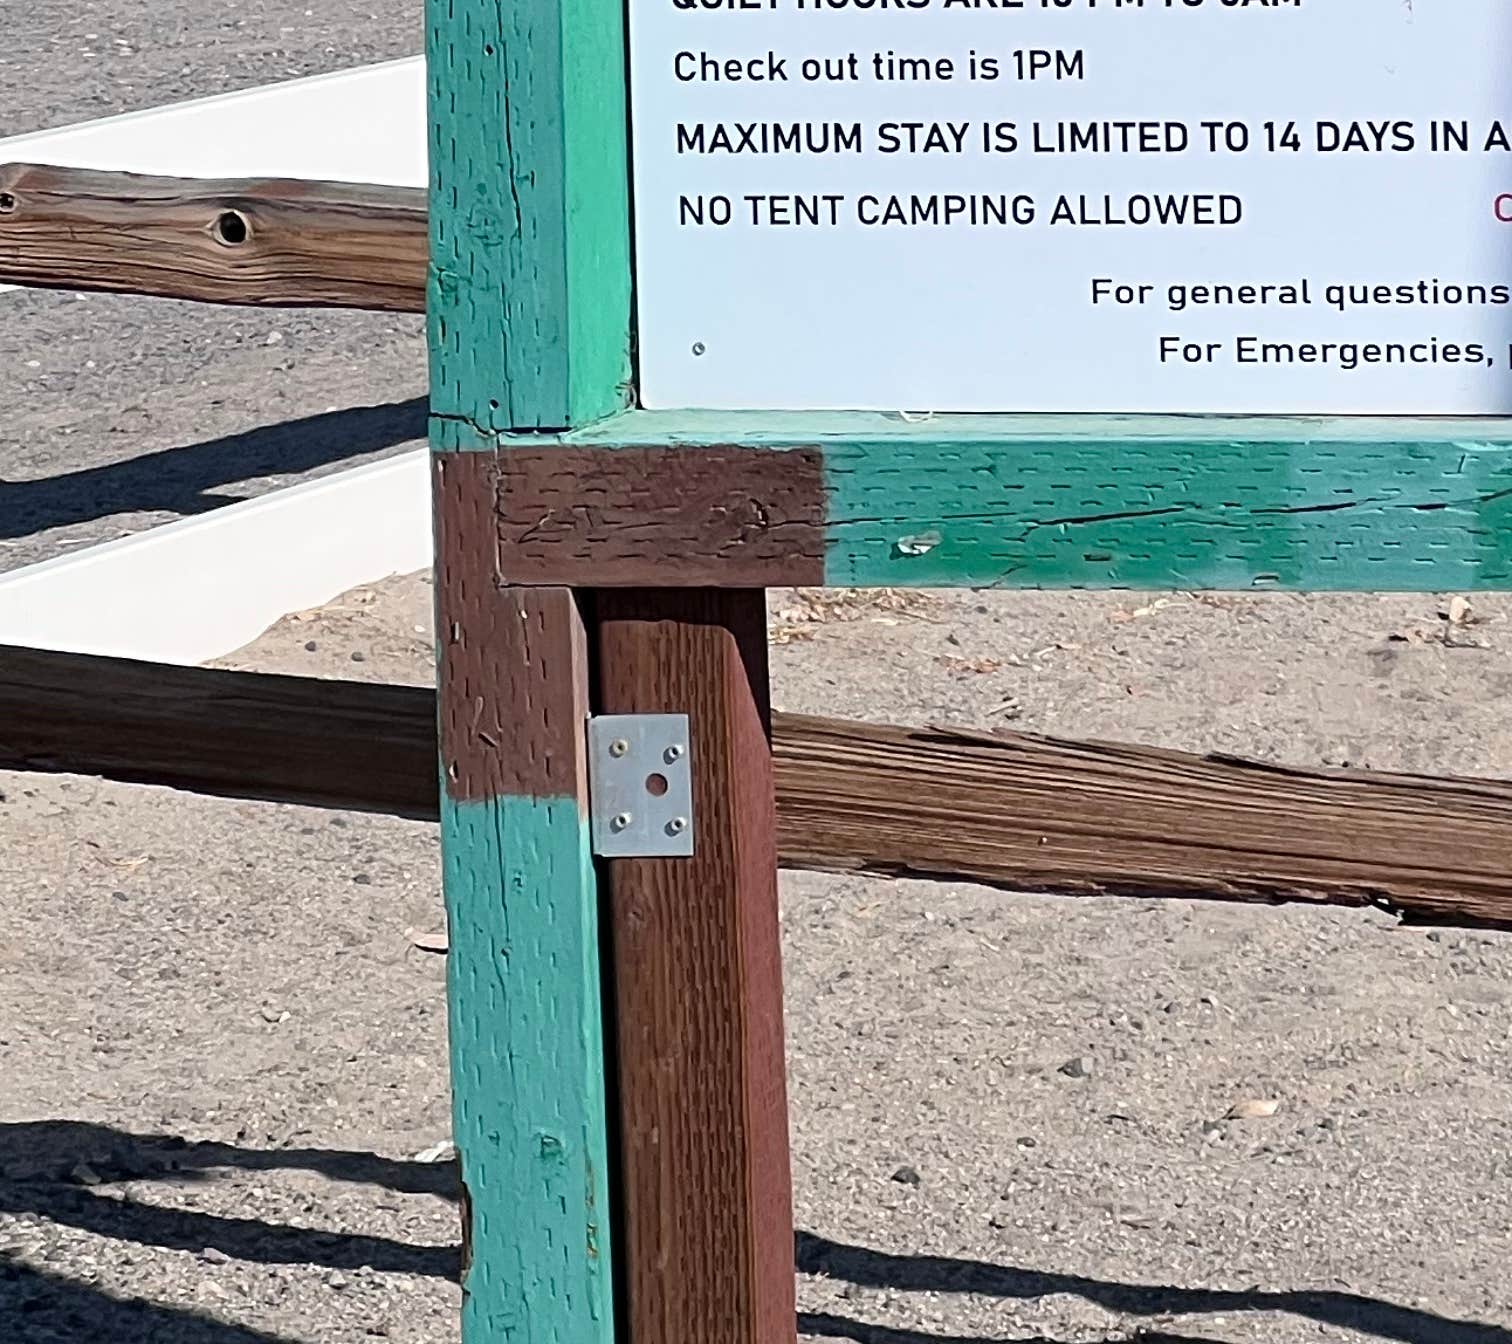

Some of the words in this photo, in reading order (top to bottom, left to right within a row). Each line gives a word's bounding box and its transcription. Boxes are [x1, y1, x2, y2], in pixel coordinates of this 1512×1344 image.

[677, 123, 861, 154] MAXIMUM
[878, 122, 969, 153] STAY
[984, 122, 1017, 152] IS
[1033, 122, 1188, 152] LIMITED
[1201, 122, 1248, 152] TO
[1264, 122, 1301, 152] 14
[1317, 121, 1414, 152] DAYS
[1431, 121, 1468, 151] IN
[680, 195, 731, 225] NO
[744, 195, 844, 225] TENT
[858, 195, 1035, 225] CAMPING
[1050, 195, 1242, 225] ALLOWED
[1092, 279, 1154, 304] For
[1168, 279, 1311, 310] general
[1160, 337, 1222, 362] For
[1237, 337, 1493, 369] Emergencies,
